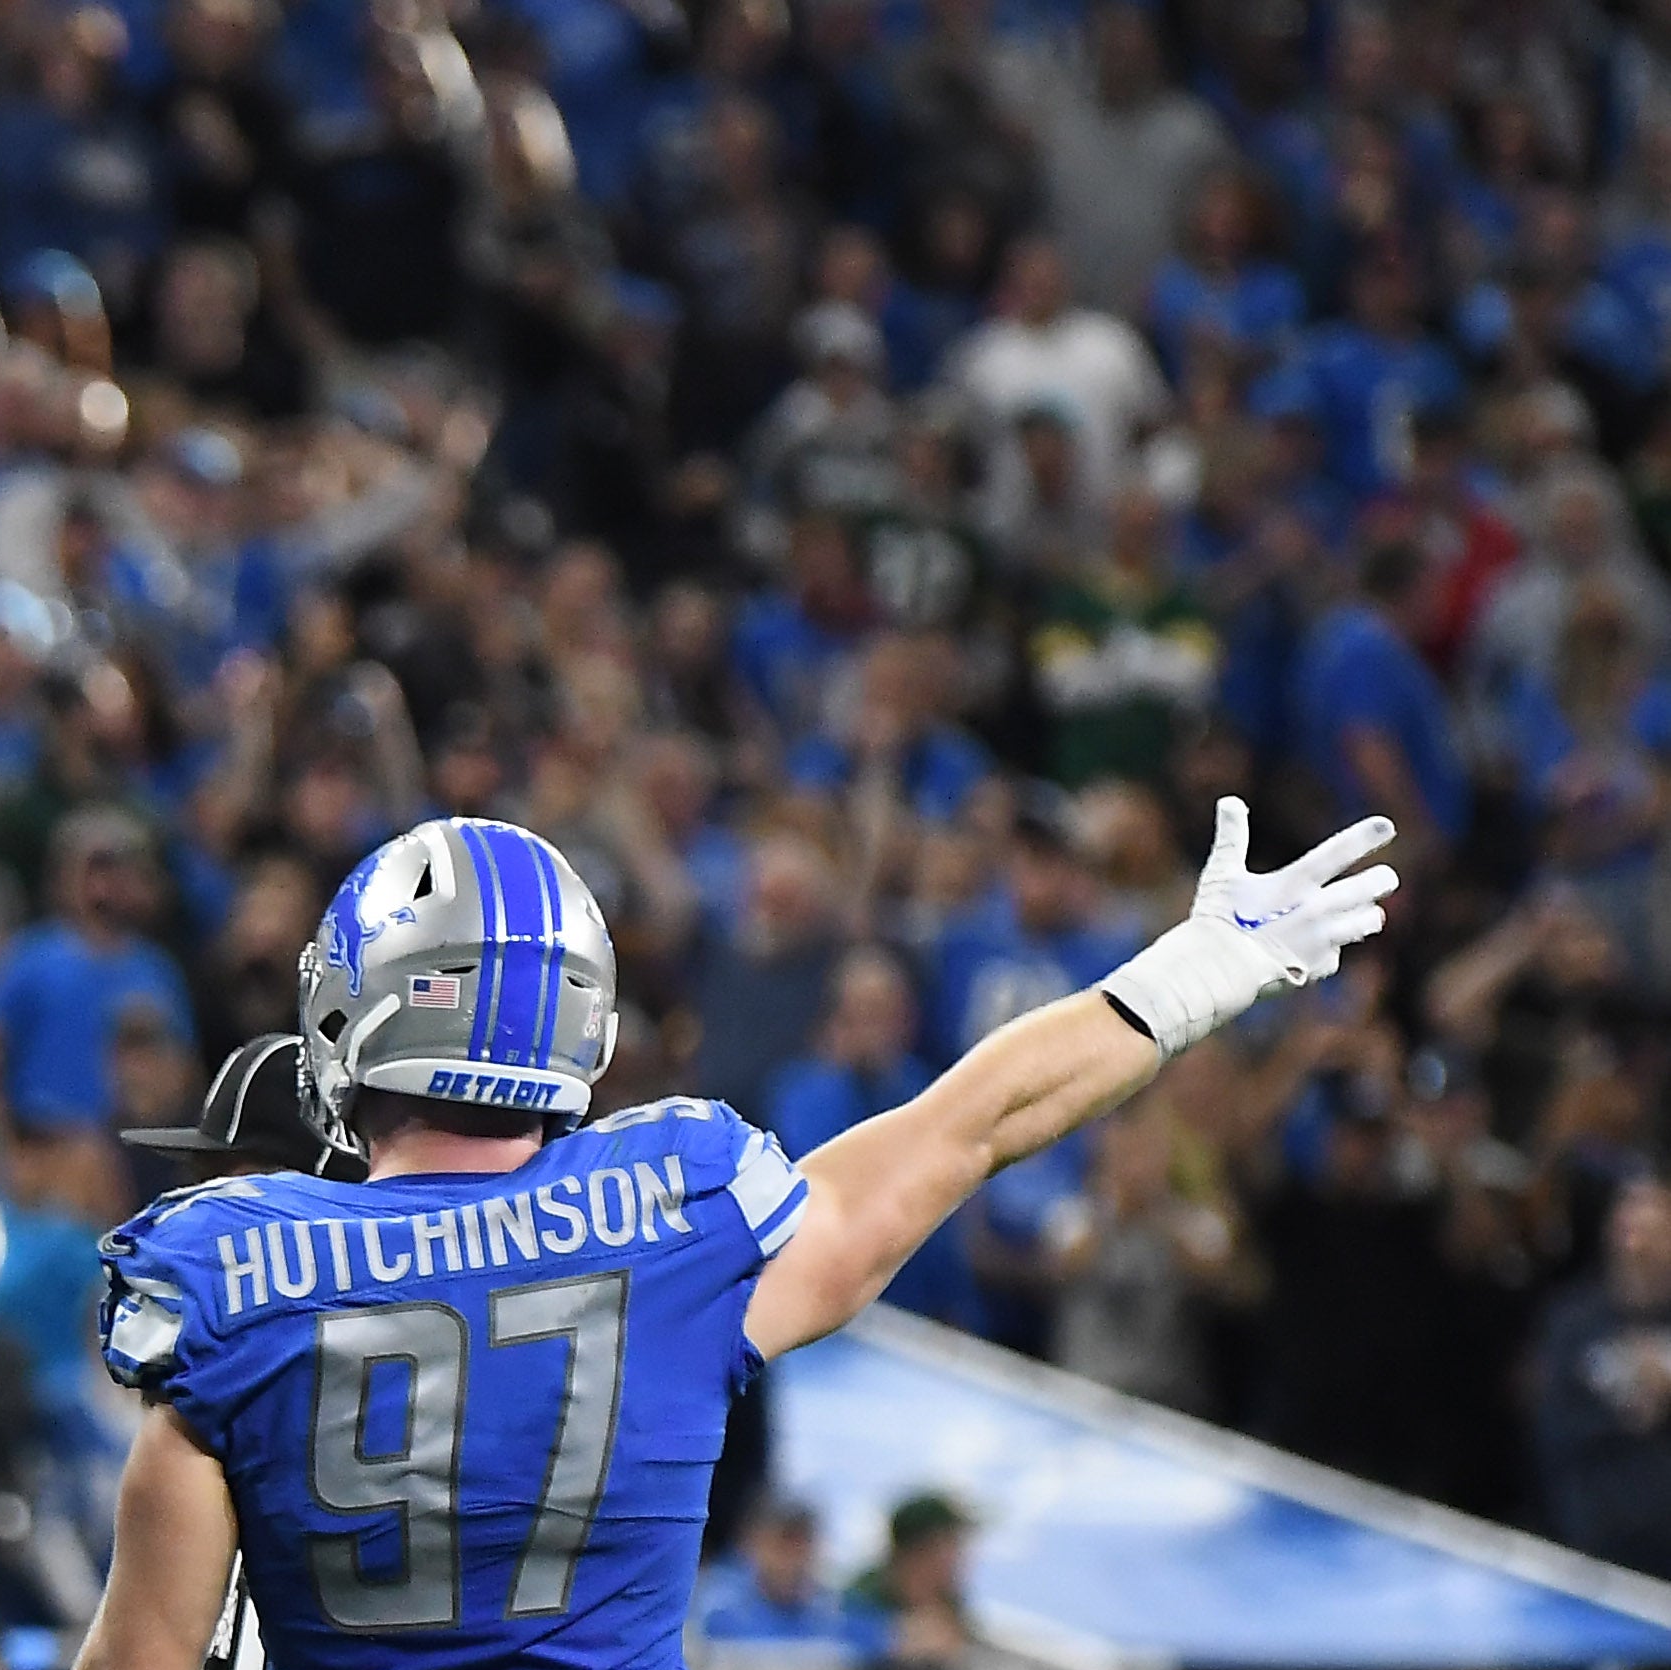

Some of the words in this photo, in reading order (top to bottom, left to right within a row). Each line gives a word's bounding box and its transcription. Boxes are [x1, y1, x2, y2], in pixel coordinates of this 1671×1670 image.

[429, 1071, 562, 1106] DETROIT
[216, 1154, 694, 1316] HUTCHINSON
[310, 1268, 632, 1637] 97
